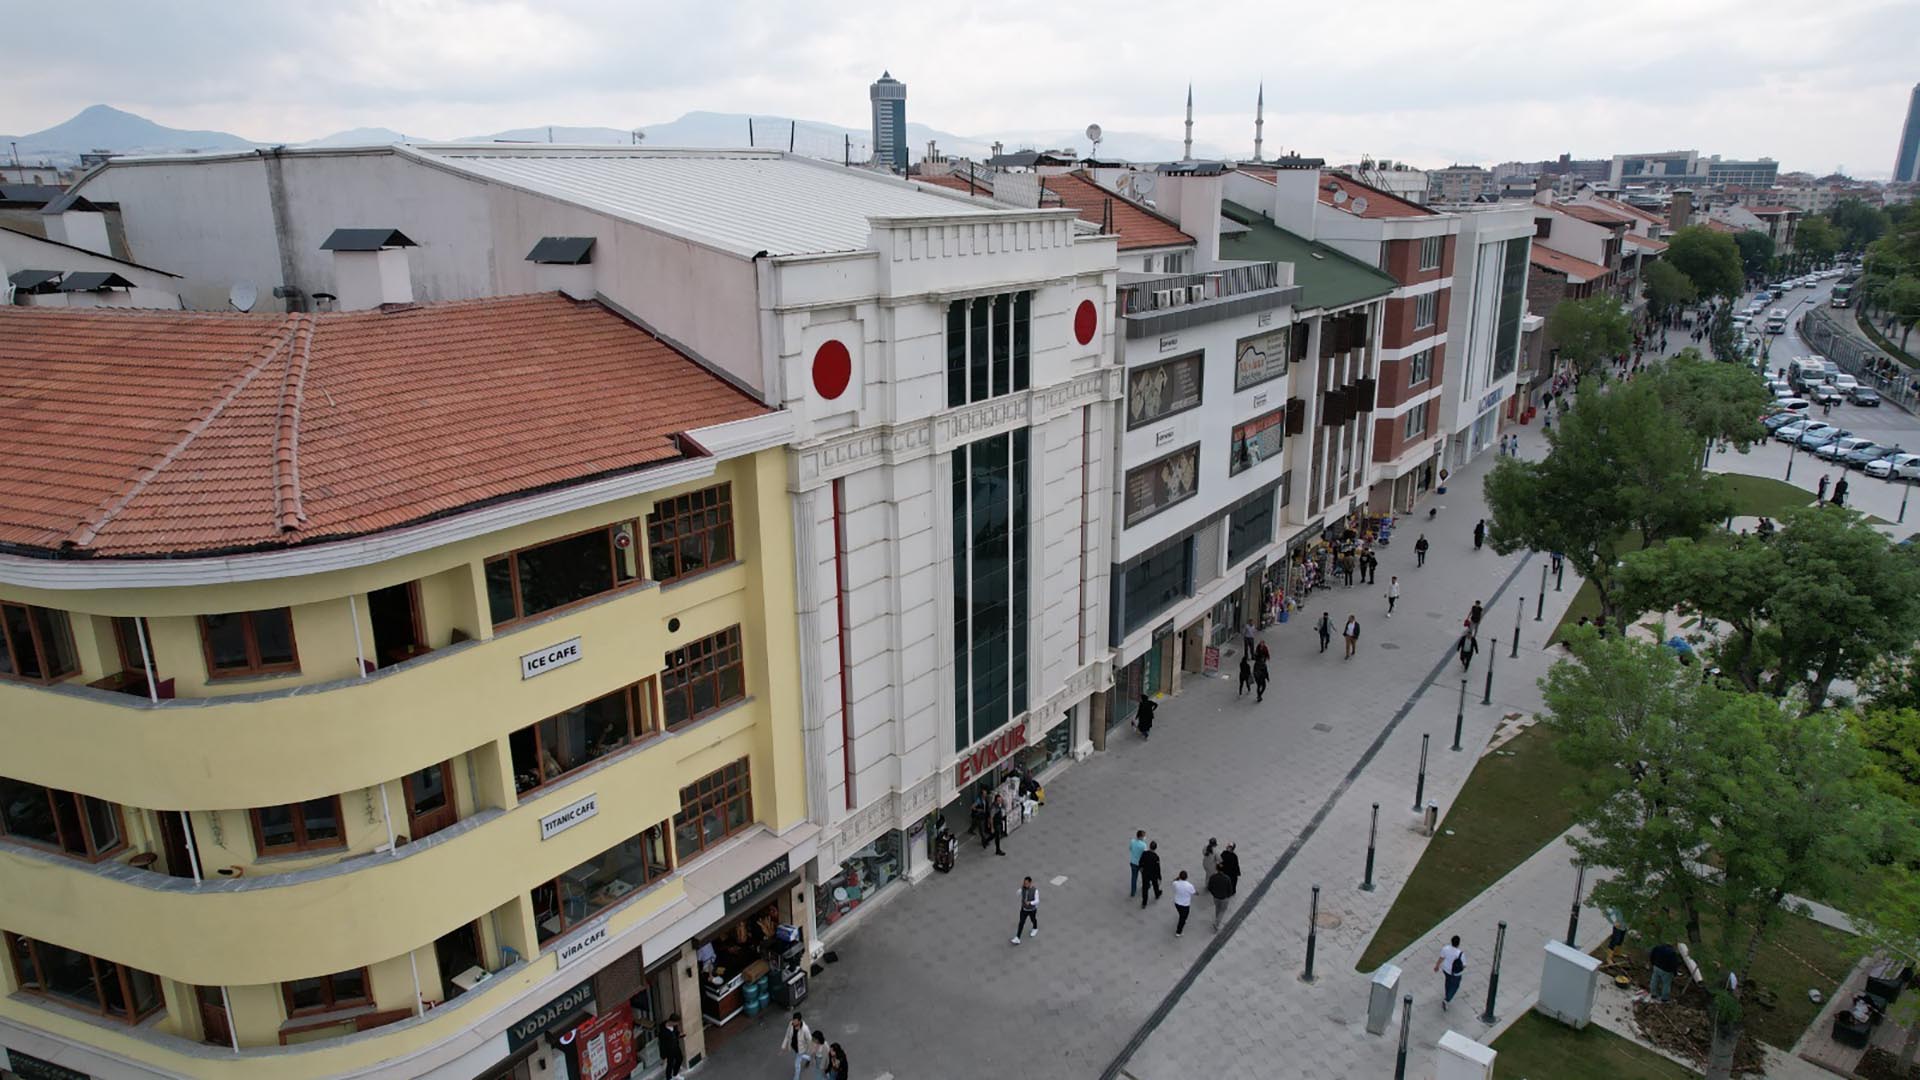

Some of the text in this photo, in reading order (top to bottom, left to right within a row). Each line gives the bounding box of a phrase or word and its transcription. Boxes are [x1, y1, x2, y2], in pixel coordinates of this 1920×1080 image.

[527, 644, 577, 671] ICE CAFE
[959, 722, 1026, 785] EVKUR
[544, 800, 595, 831] TITANIC CAFE
[561, 928, 606, 960] VİRA CAFE
[515, 985, 592, 1040] VODAFONE
